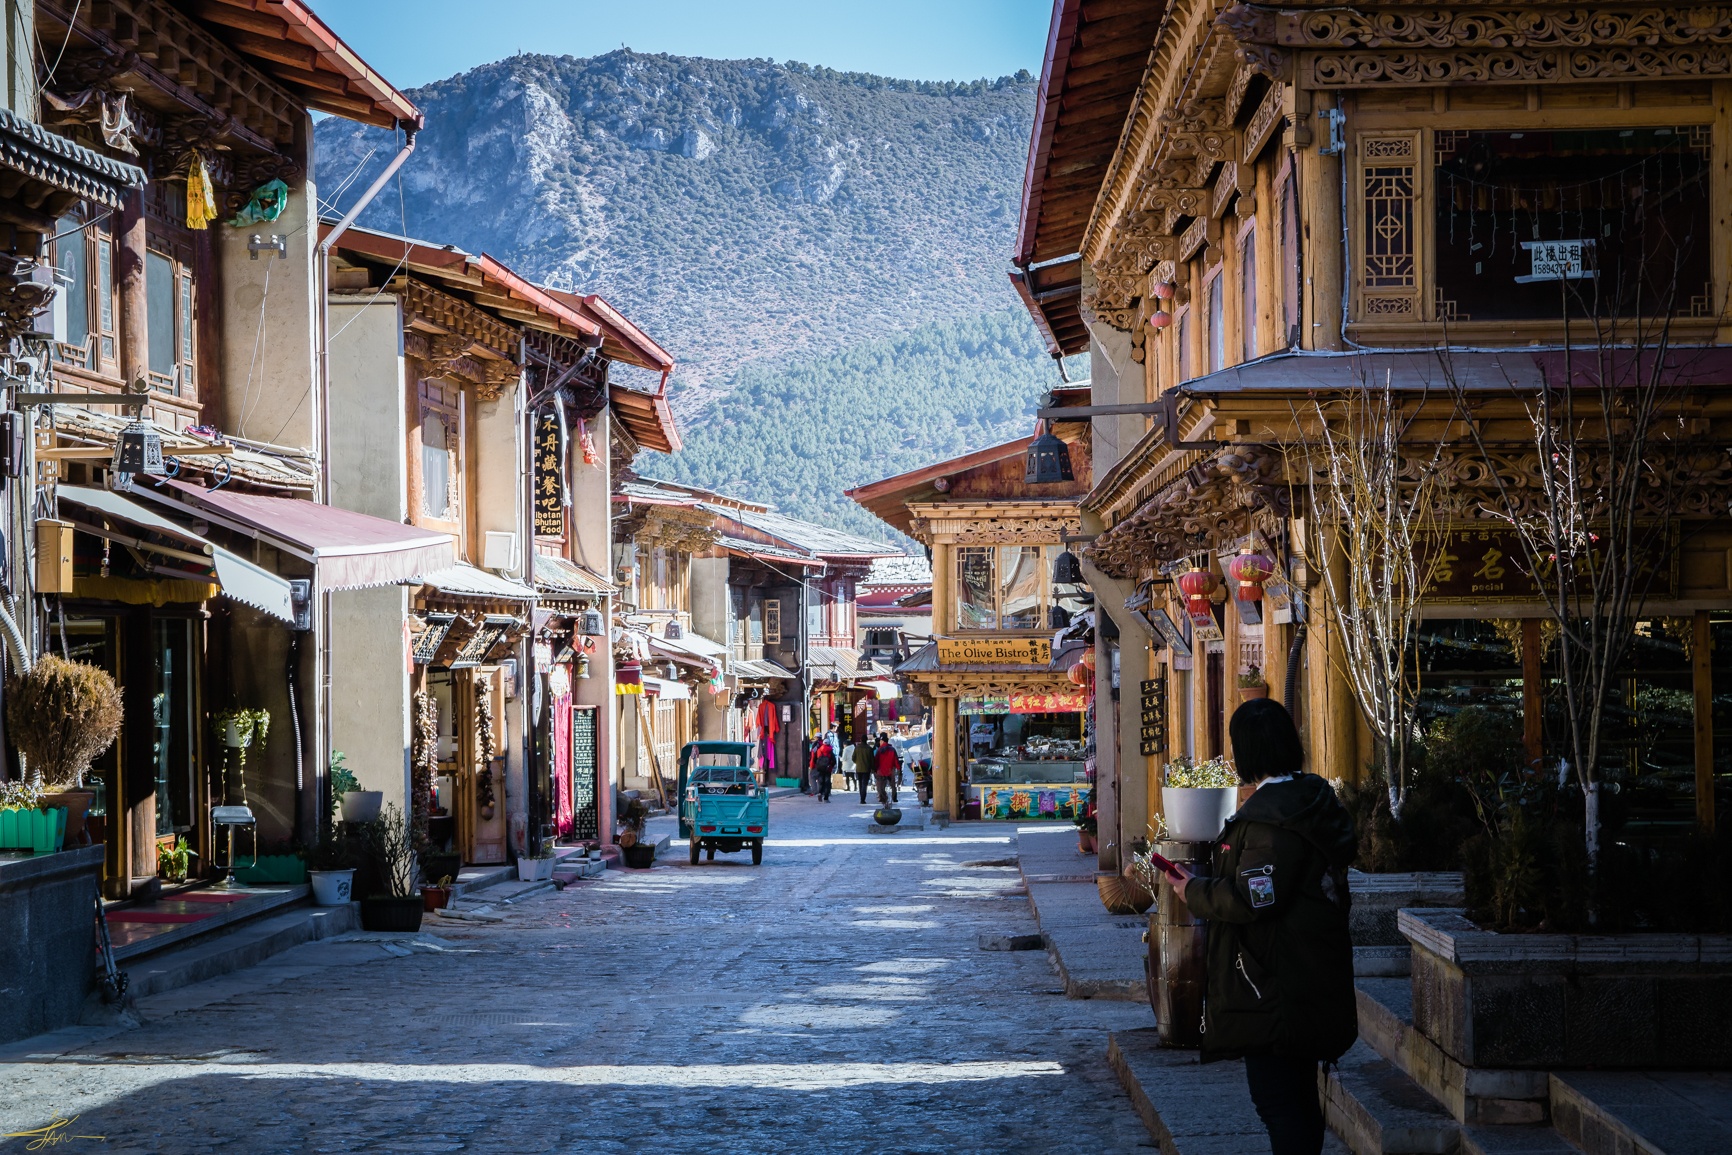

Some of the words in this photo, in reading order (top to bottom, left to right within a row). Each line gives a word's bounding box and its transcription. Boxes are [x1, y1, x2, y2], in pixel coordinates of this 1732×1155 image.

[1533, 244, 1580, 262] 此楼出租
[535, 518, 561, 526] Bhutan
[541, 526, 562, 534] Food
[939, 648, 961, 658] The
[963, 646, 993, 658] Olive
[996, 646, 1029, 658] Bistro
[1144, 681, 1159, 692] 三七
[1145, 696, 1159, 707] 天麻
[985, 788, 1084, 816] 手撕牛
